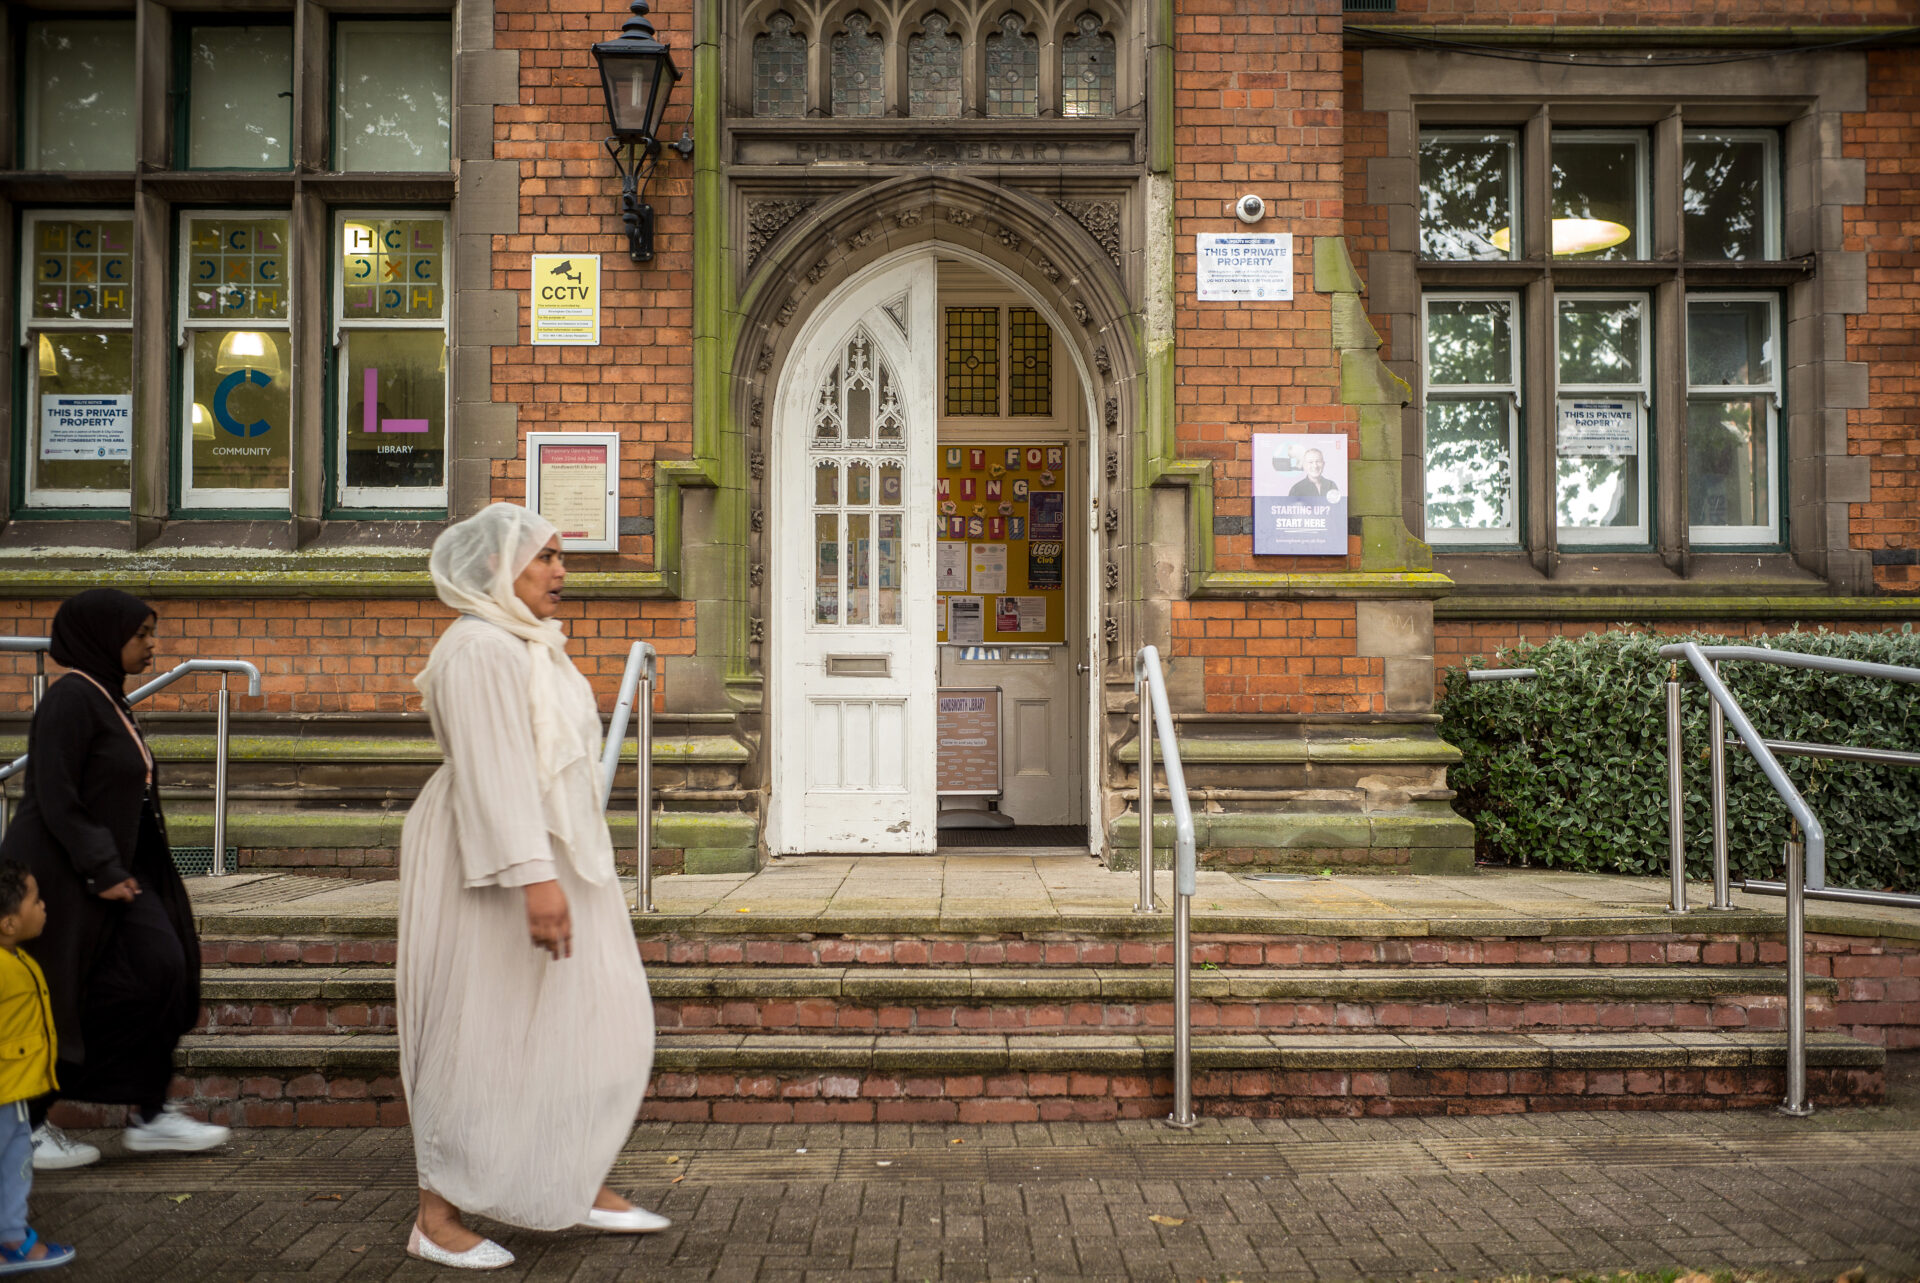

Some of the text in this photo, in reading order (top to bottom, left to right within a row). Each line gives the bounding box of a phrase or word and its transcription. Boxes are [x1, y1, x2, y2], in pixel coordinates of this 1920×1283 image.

[1204, 248, 1287, 256] THIS IS PRIVATE
[1217, 257, 1273, 266] PROPERTY
[541, 286, 590, 300] CCTV
[213, 369, 272, 438] C
[363, 368, 429, 433] L
[48, 409, 128, 417] THIS IS PRIVATE
[1596, 411, 1632, 419] PRIVATE
[60, 418, 115, 426] PROPERTY
[213, 447, 272, 456] COMMUNITY
[377, 445, 414, 454] LIBRARY
[947, 448, 1063, 465] UT FOR
[1271, 505, 1331, 516] STARTING UP?
[1276, 518, 1326, 528] START HERE
[1032, 543, 1061, 556] LEGO
[1037, 556, 1054, 564] Club
[940, 697, 985, 712] HANDSWORTH LIBRARY
